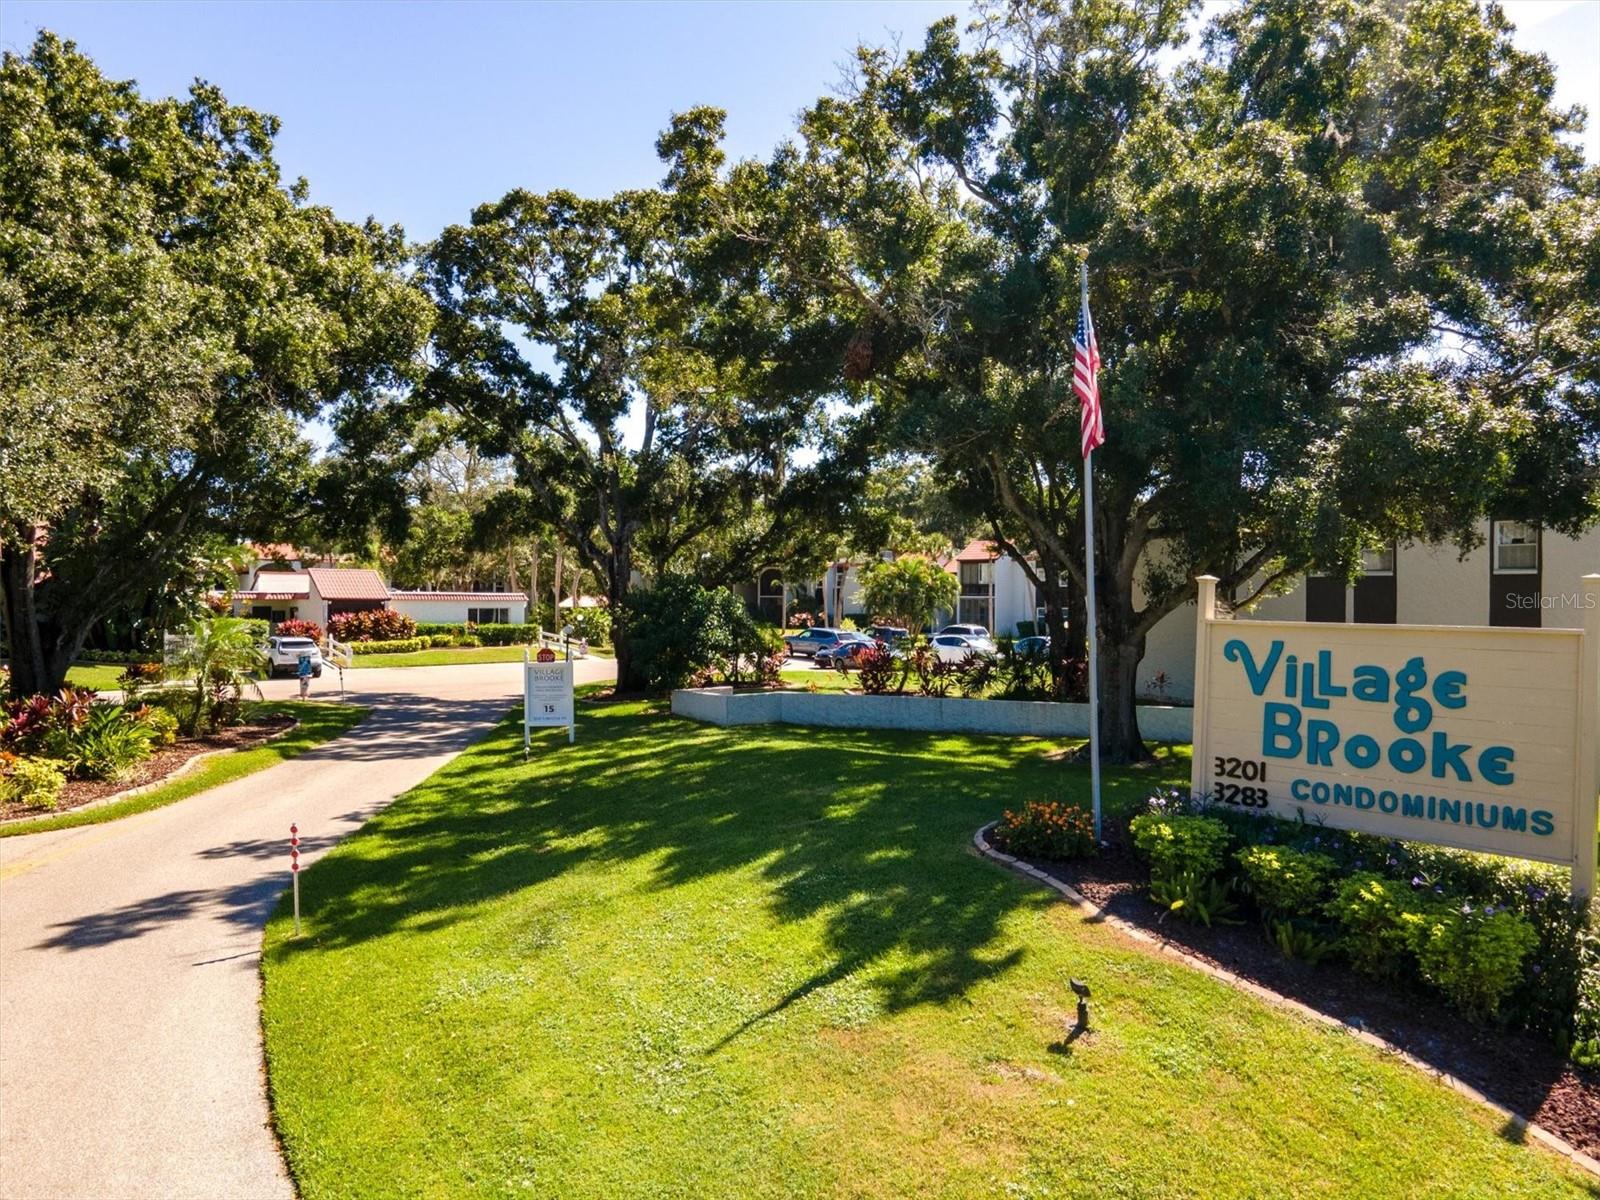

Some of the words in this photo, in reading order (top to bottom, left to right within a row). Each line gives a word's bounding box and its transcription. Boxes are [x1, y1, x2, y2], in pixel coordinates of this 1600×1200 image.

[538, 653, 555, 661] STOP
[1214, 756, 1267, 783] 3201
[1214, 782, 1269, 808] 3283
[1290, 778, 1555, 837] CONDOMINIUMS
